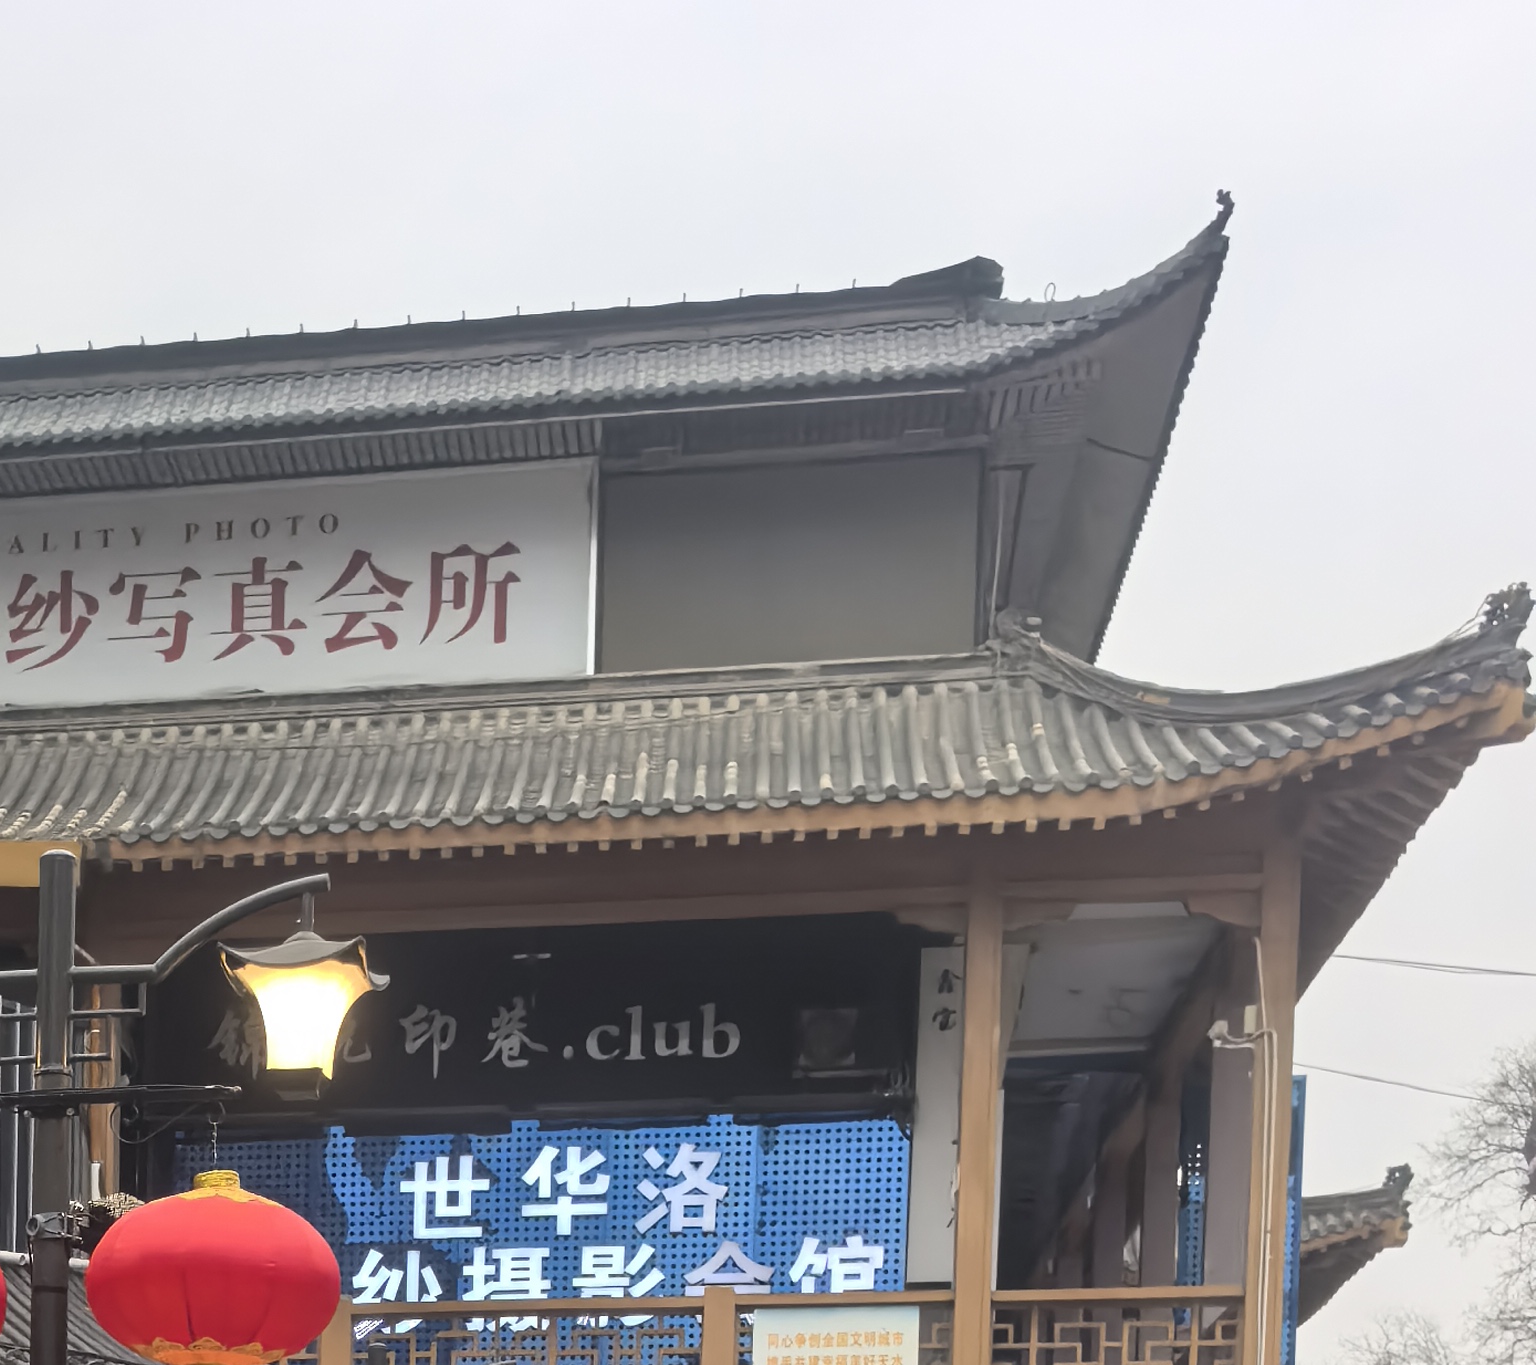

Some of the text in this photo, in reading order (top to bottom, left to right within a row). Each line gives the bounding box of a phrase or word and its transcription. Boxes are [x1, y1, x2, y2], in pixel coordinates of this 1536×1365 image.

[183, 512, 340, 544] PHOTO
[399, 1143, 729, 1240] 世华洛
[767, 1331, 904, 1350] 同心争创全国文明城市
